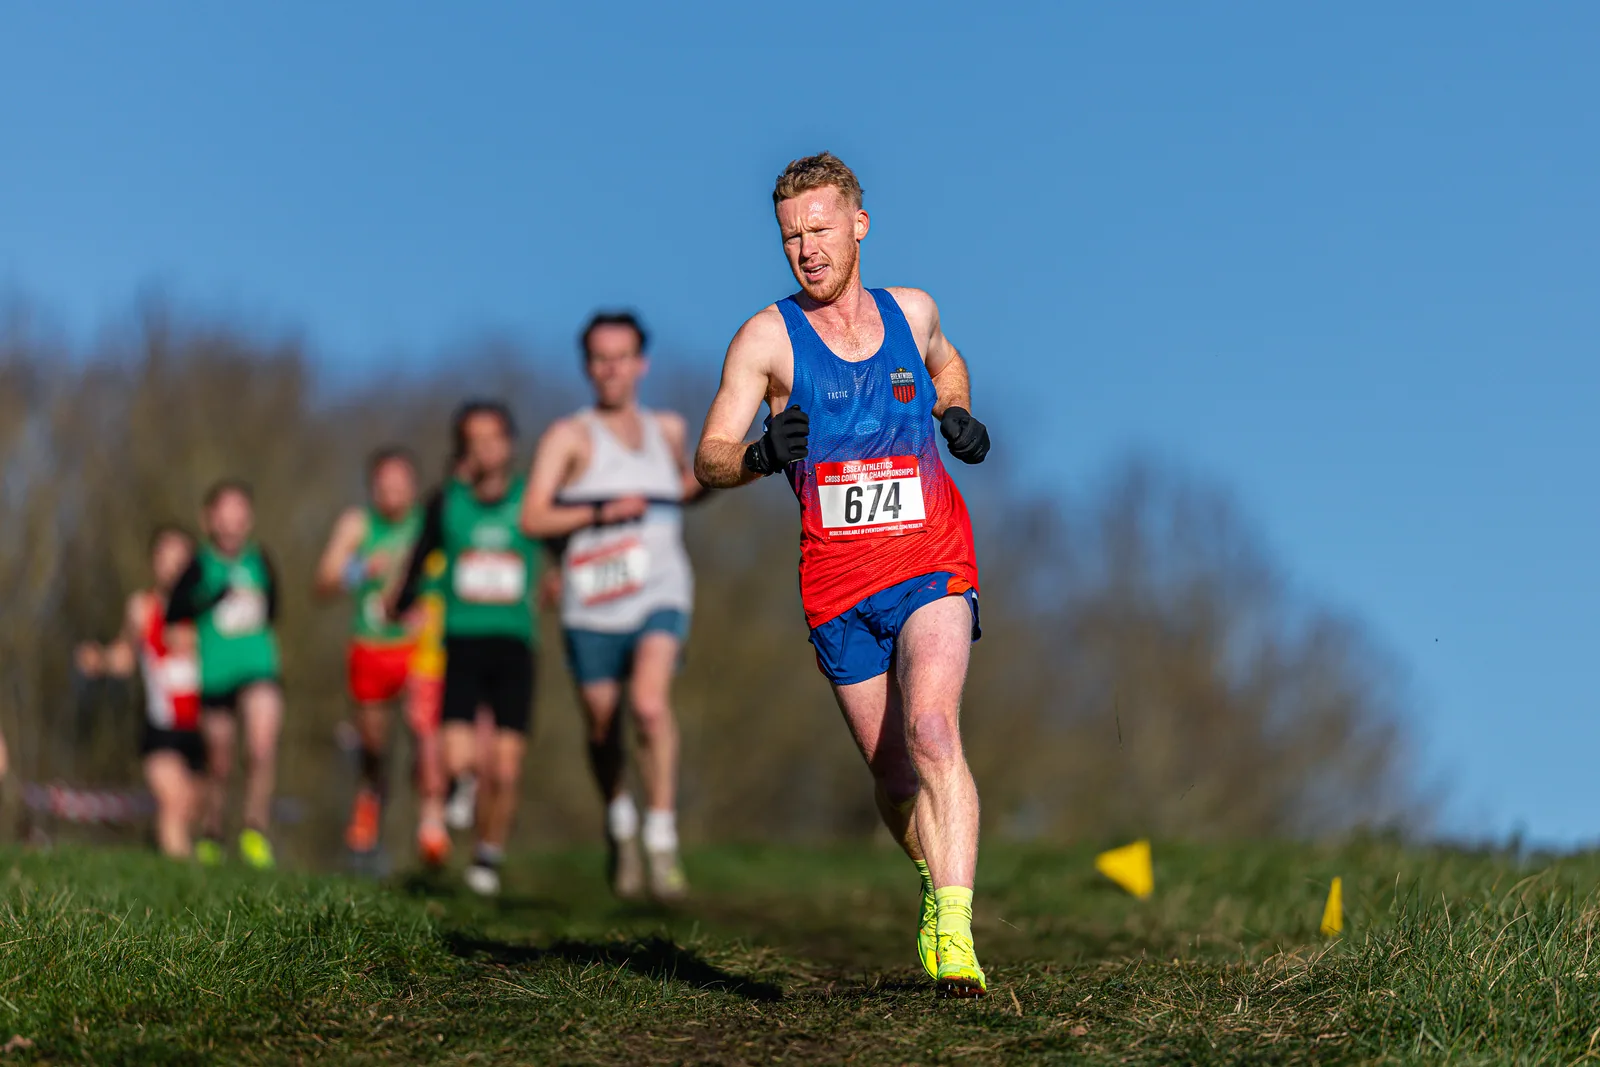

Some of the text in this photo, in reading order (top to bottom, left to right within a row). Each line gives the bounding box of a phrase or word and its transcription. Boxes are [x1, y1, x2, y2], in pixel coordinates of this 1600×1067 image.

[827, 390, 848, 400] TACTIC
[843, 461, 893, 474] ESSEX ATHLETICS
[825, 467, 914, 483] CROSS COUNTRY CHAMPIONSHIPS
[845, 481, 902, 524] 674
